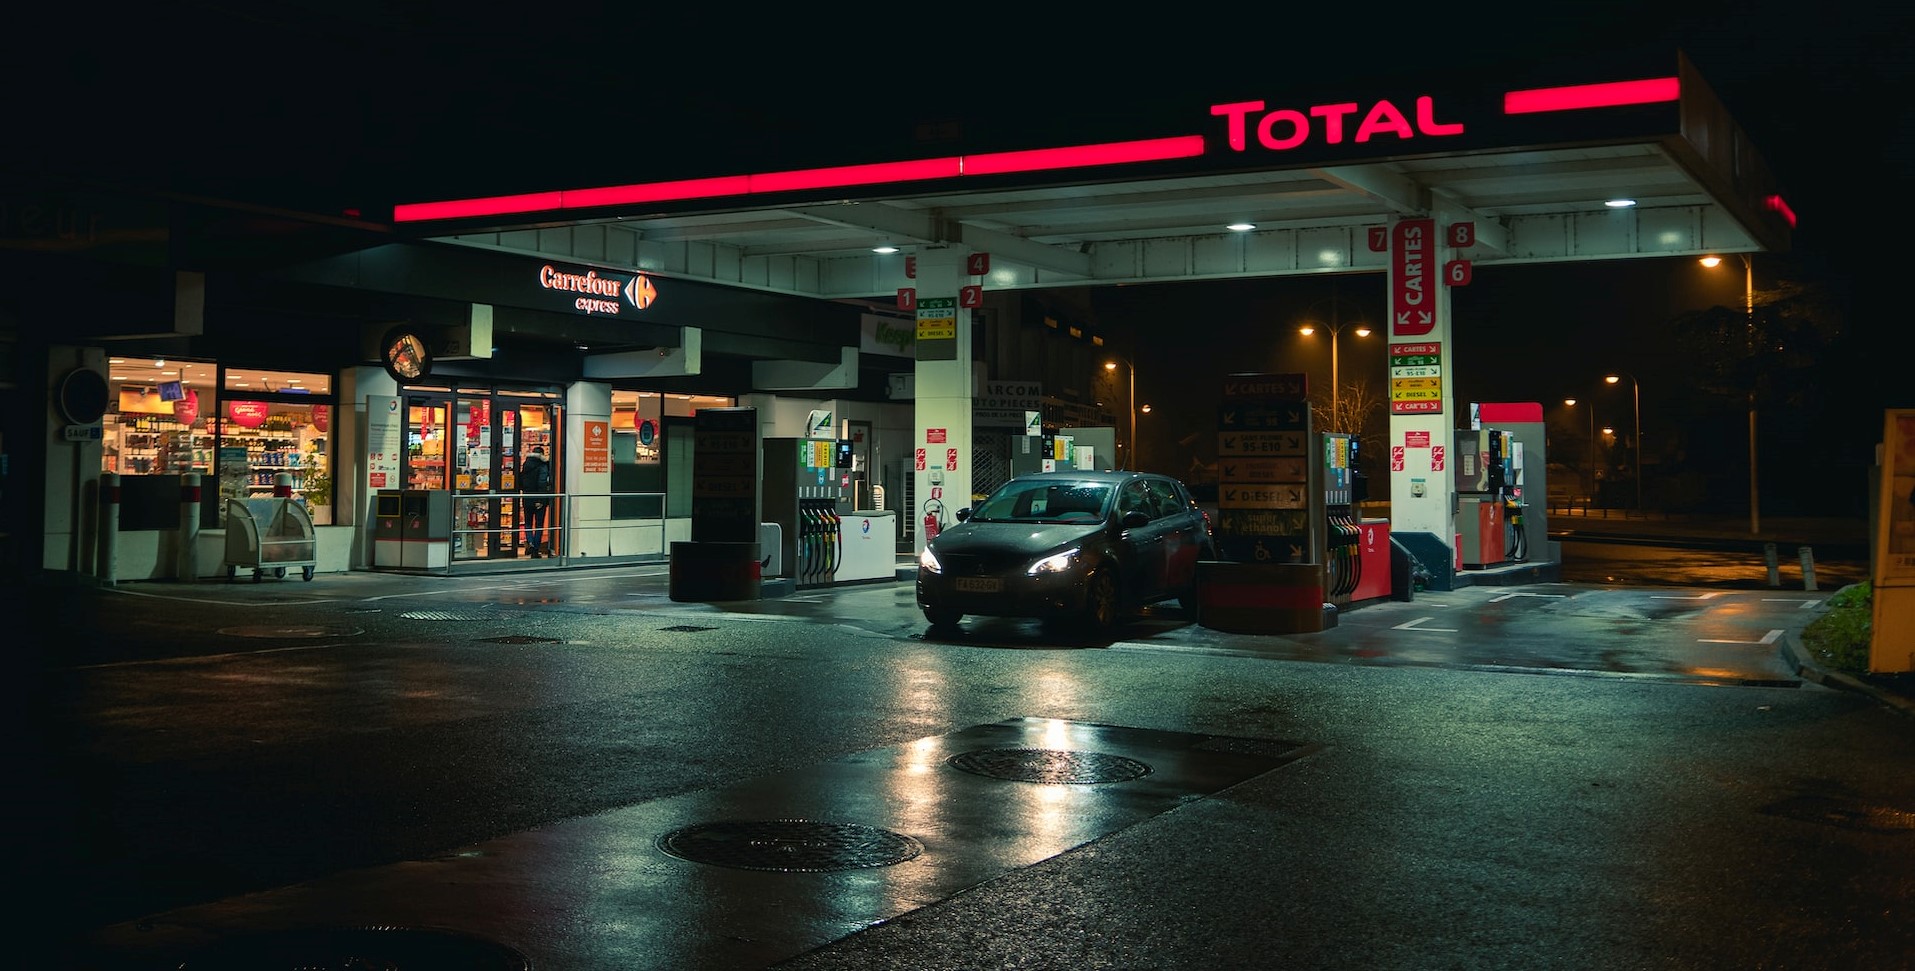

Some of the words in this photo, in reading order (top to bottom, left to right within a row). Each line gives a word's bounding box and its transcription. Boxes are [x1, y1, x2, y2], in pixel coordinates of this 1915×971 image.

[1210, 96, 1464, 151] TOTAL
[1375, 231, 1386, 248] 7
[1456, 226, 1468, 244] 8
[973, 256, 984, 272] 4
[1405, 226, 1423, 306] CARTES
[1452, 263, 1464, 282] 6
[540, 264, 621, 297] Carrefour
[903, 291, 911, 307] 1
[966, 288, 977, 305] 2
[575, 297, 620, 315] express
[1239, 383, 1286, 394] CARTES
[67, 429, 88, 437] SAUF
[1243, 442, 1281, 452] 95-E10
